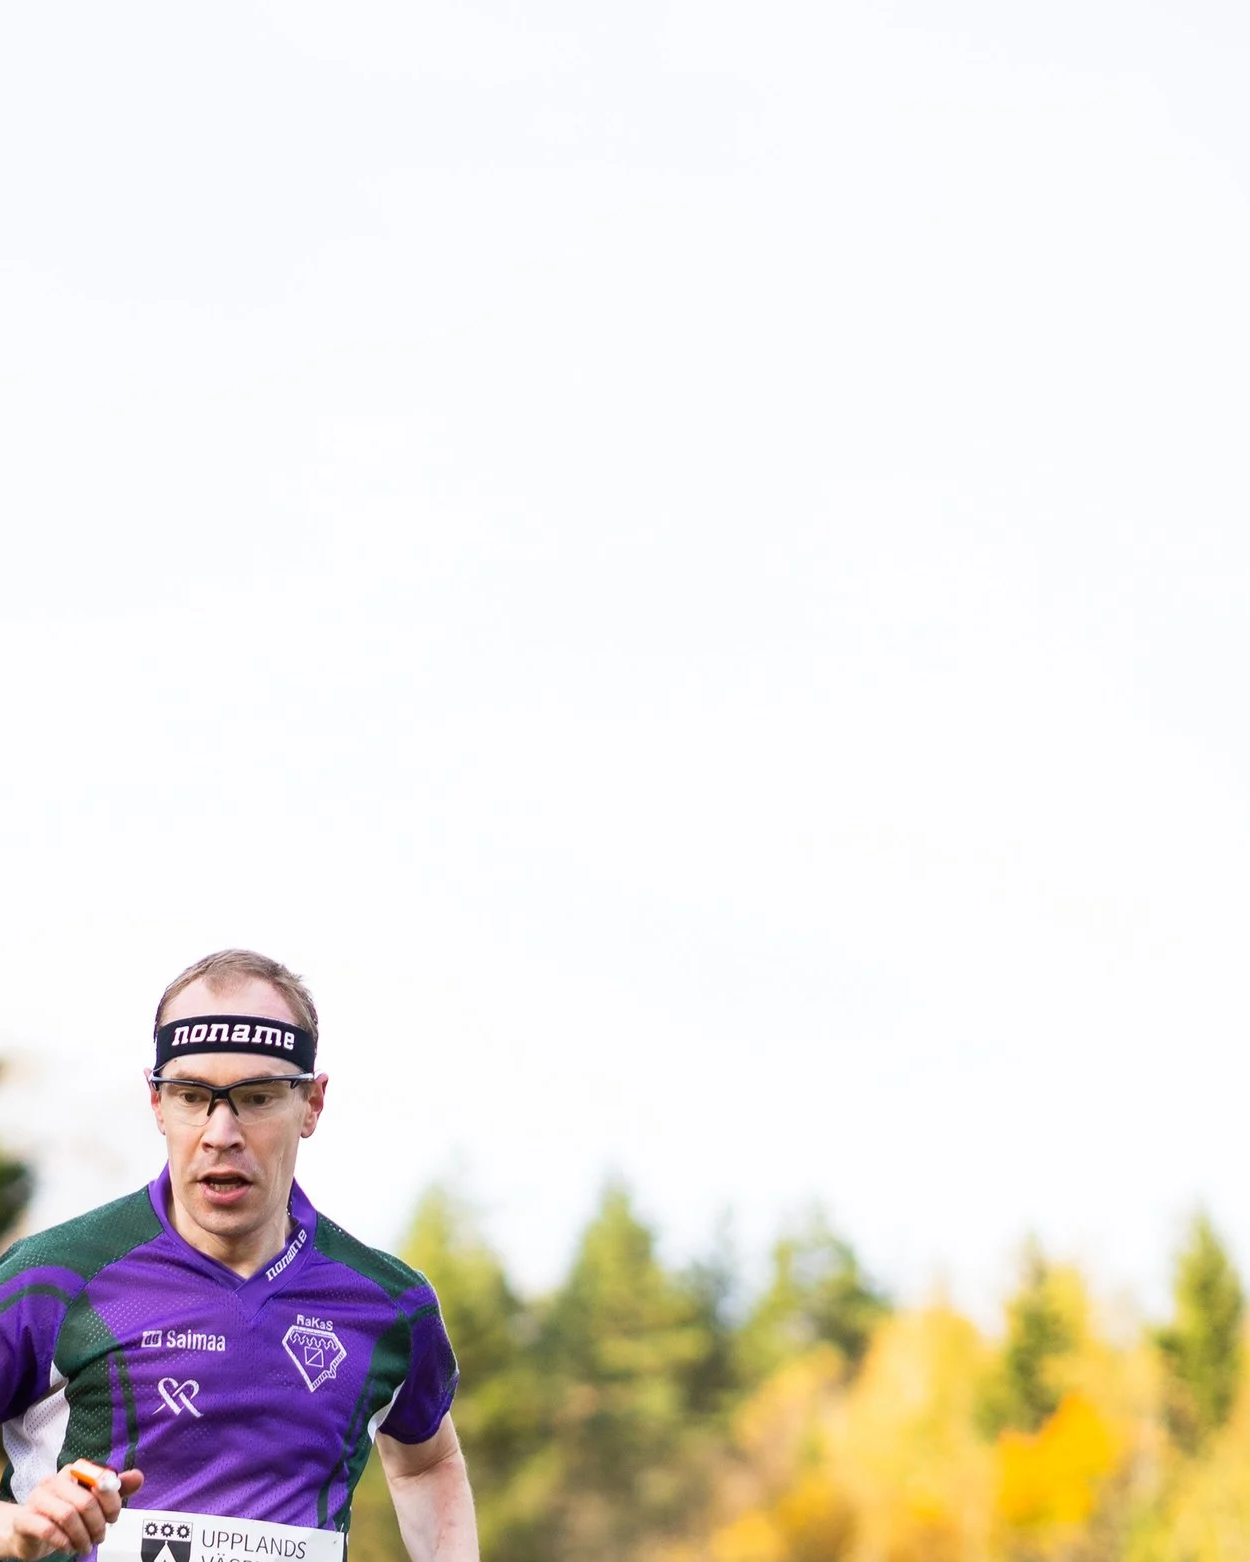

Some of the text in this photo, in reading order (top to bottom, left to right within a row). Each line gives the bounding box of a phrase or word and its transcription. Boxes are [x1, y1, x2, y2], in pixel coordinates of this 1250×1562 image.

[171, 1023, 295, 1050] noname
[265, 1229, 308, 1282] noname
[166, 1329, 226, 1352] Saimaa
[202, 1530, 307, 1560] UPPLANDS
